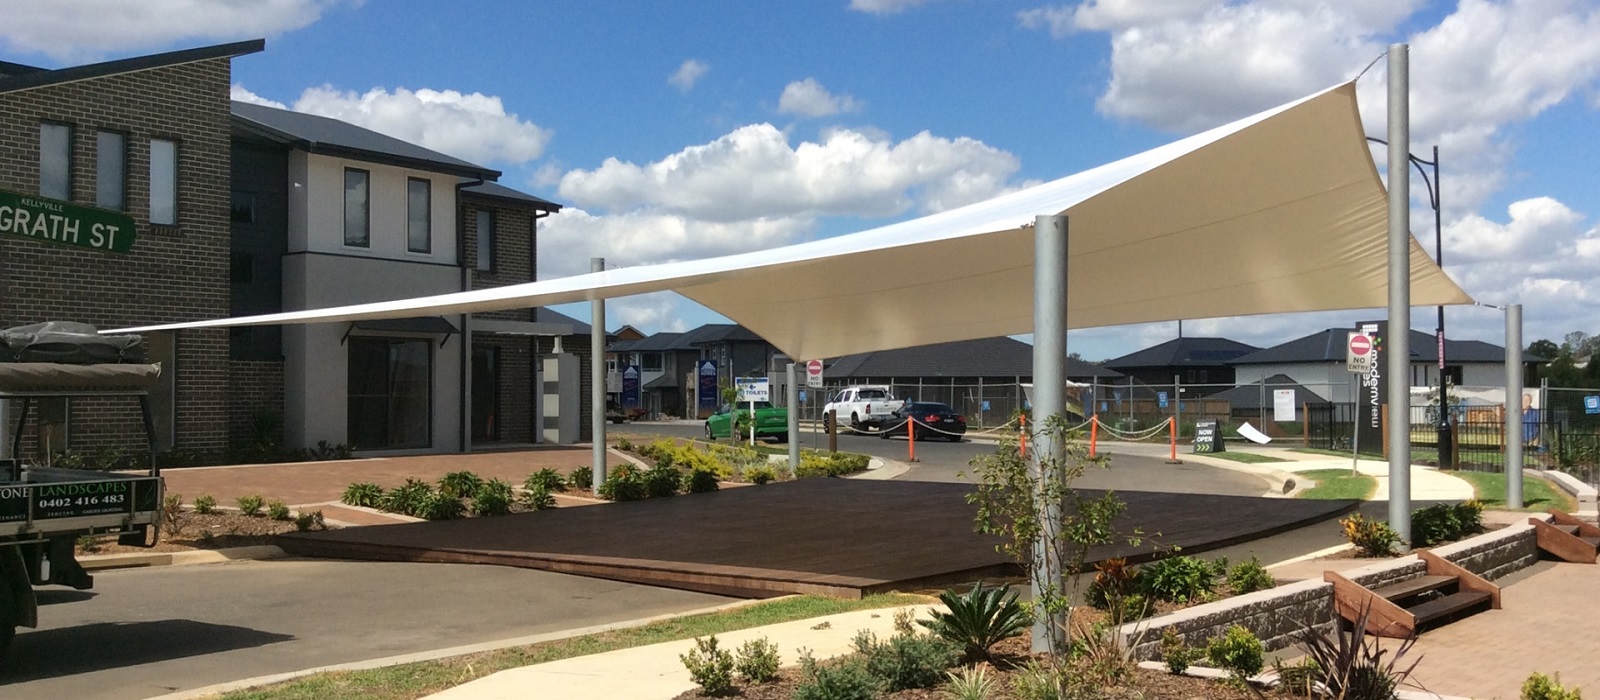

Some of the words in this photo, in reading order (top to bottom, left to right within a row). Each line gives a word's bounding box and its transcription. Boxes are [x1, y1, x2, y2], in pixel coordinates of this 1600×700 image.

[21, 198, 64, 212] KELLYVILLE
[89, 222, 120, 250] ST
[1348, 363, 1369, 371] ENTRY
[39, 481, 127, 497] LANDSCAPES
[39, 497, 71, 508] 0402
[74, 496, 98, 505] 416
[101, 494, 125, 503] 483
